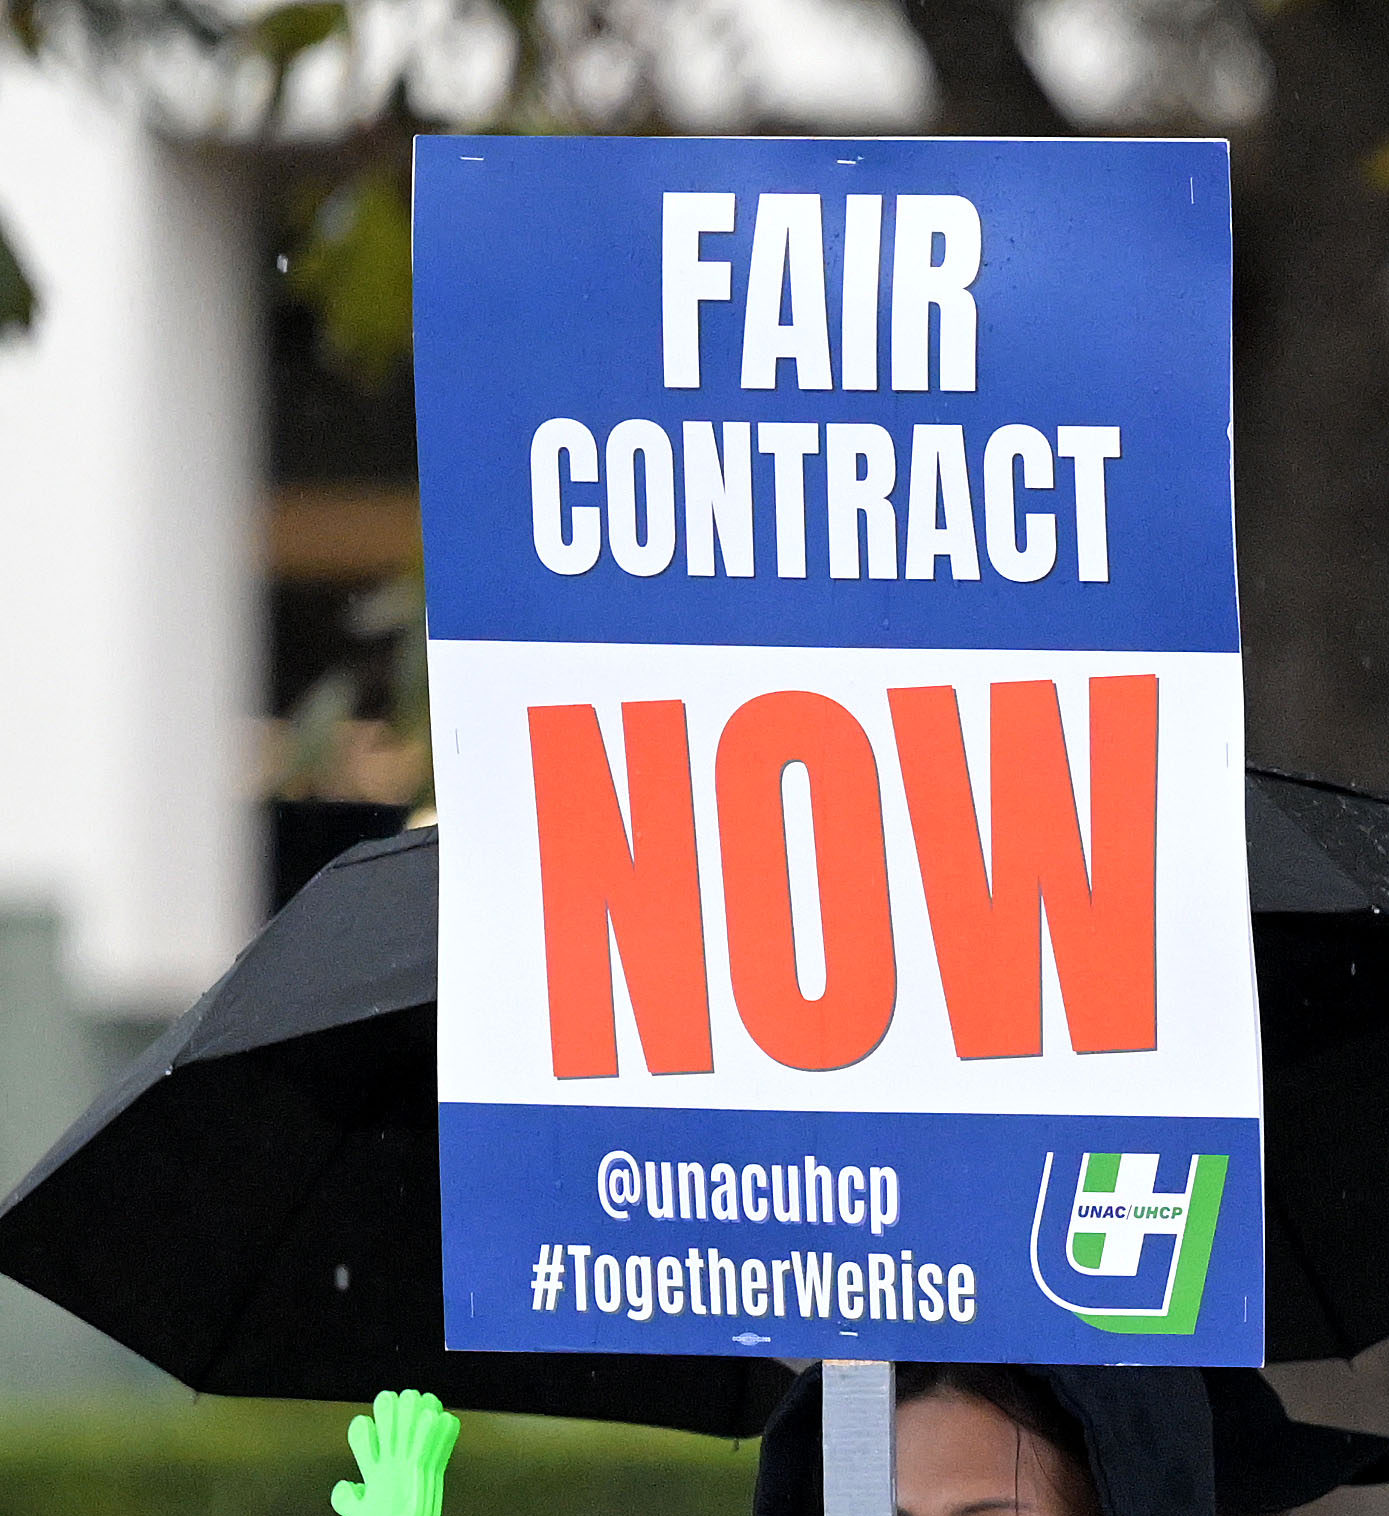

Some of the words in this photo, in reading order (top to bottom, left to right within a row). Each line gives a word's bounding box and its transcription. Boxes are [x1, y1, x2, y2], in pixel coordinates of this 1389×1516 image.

[661, 192, 983, 392] FAIR
[529, 417, 1121, 584] CONTRACT
[527, 673, 1159, 1080] NOW
[597, 1150, 899, 1234] @unacuhcp
[1077, 1204, 1184, 1220] UNAC/UHCP
[531, 1243, 977, 1323] #TogetherWeRise
